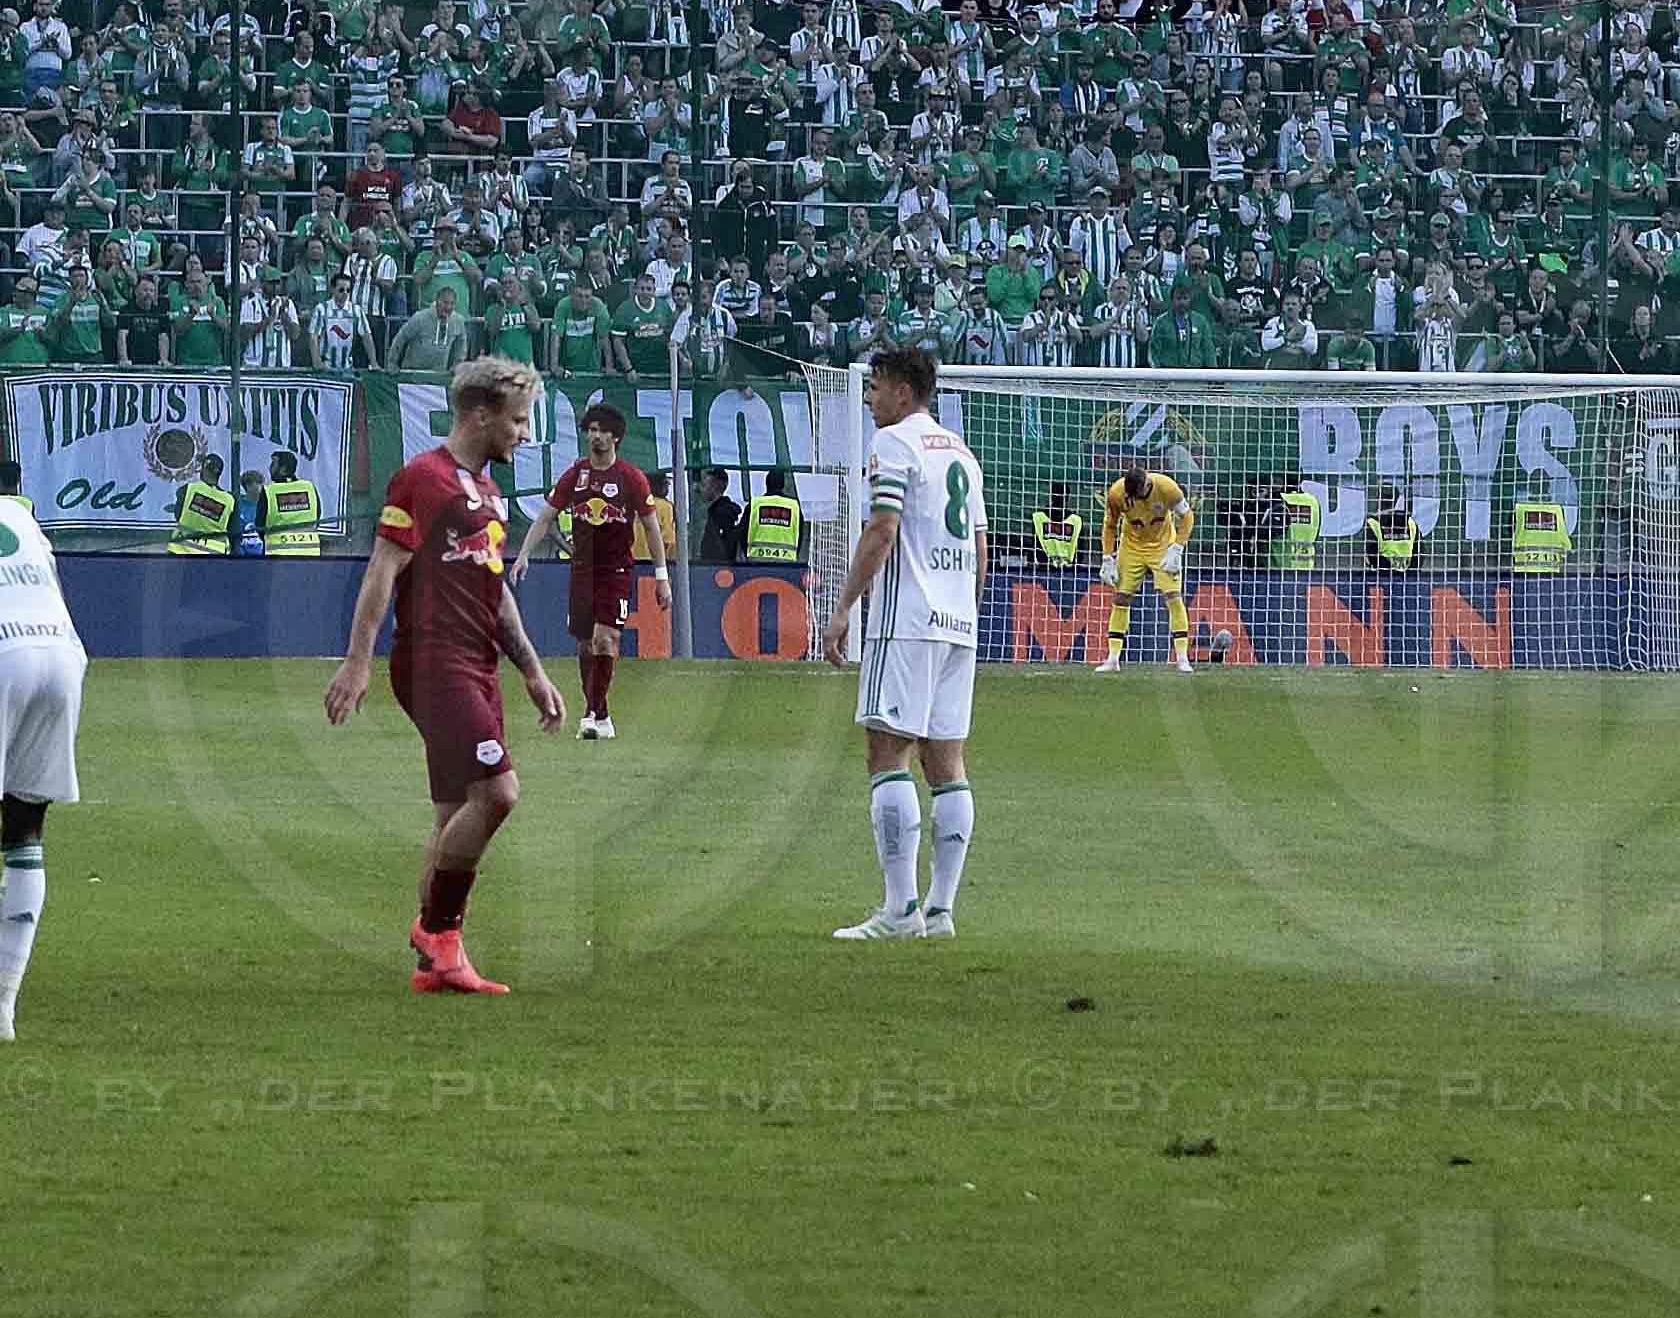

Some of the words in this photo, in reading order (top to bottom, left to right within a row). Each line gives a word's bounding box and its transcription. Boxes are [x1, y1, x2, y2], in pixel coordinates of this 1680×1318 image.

[38, 378, 188, 453] VIRIBUS
[56, 478, 149, 511] Old
[943, 460, 970, 541] 8
[1299, 402, 1582, 541] BOYS
